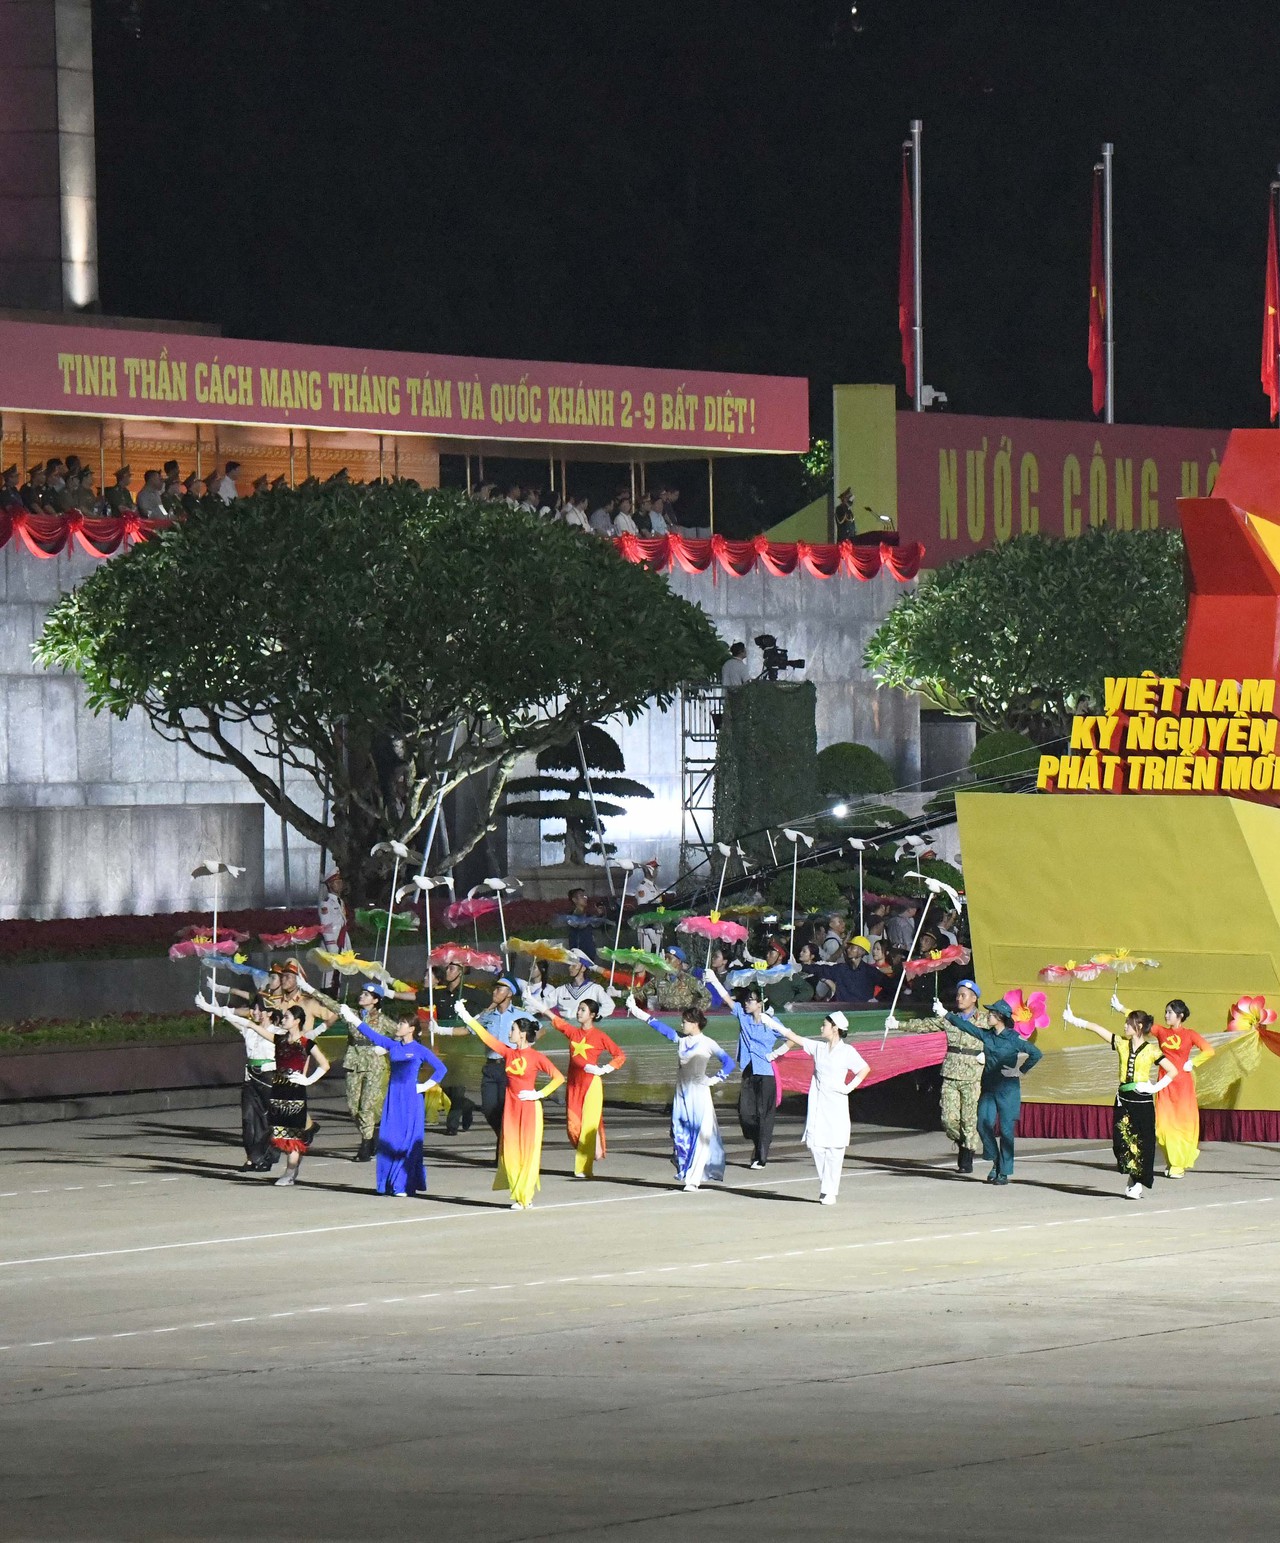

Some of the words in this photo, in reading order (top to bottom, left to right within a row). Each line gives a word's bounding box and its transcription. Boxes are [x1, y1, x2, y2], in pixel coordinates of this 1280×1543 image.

[58, 353, 118, 397] TINH
[124, 344, 187, 402] THẦN
[195, 355, 254, 406] CÁCH
[260, 367, 322, 417] MẠNG
[328, 366, 401, 416] THÁNG
[406, 371, 452, 418] TÁM
[458, 373, 485, 420] VÀ
[490, 373, 542, 424] QUỐC
[548, 380, 614, 427] KHÁNH
[661, 382, 699, 431] BẤT
[704, 389, 756, 440] DIỆT!
[938, 435, 1039, 543] NƯỚC
[1103, 670, 1181, 718] VIỆT
[1186, 679, 1276, 713] NAM
[1070, 703, 1120, 750] KỶ
[1126, 711, 1278, 752] NGUYÊN
[1036, 749, 1121, 790] PHÁT
[1127, 746, 1218, 790] TRIỂN
